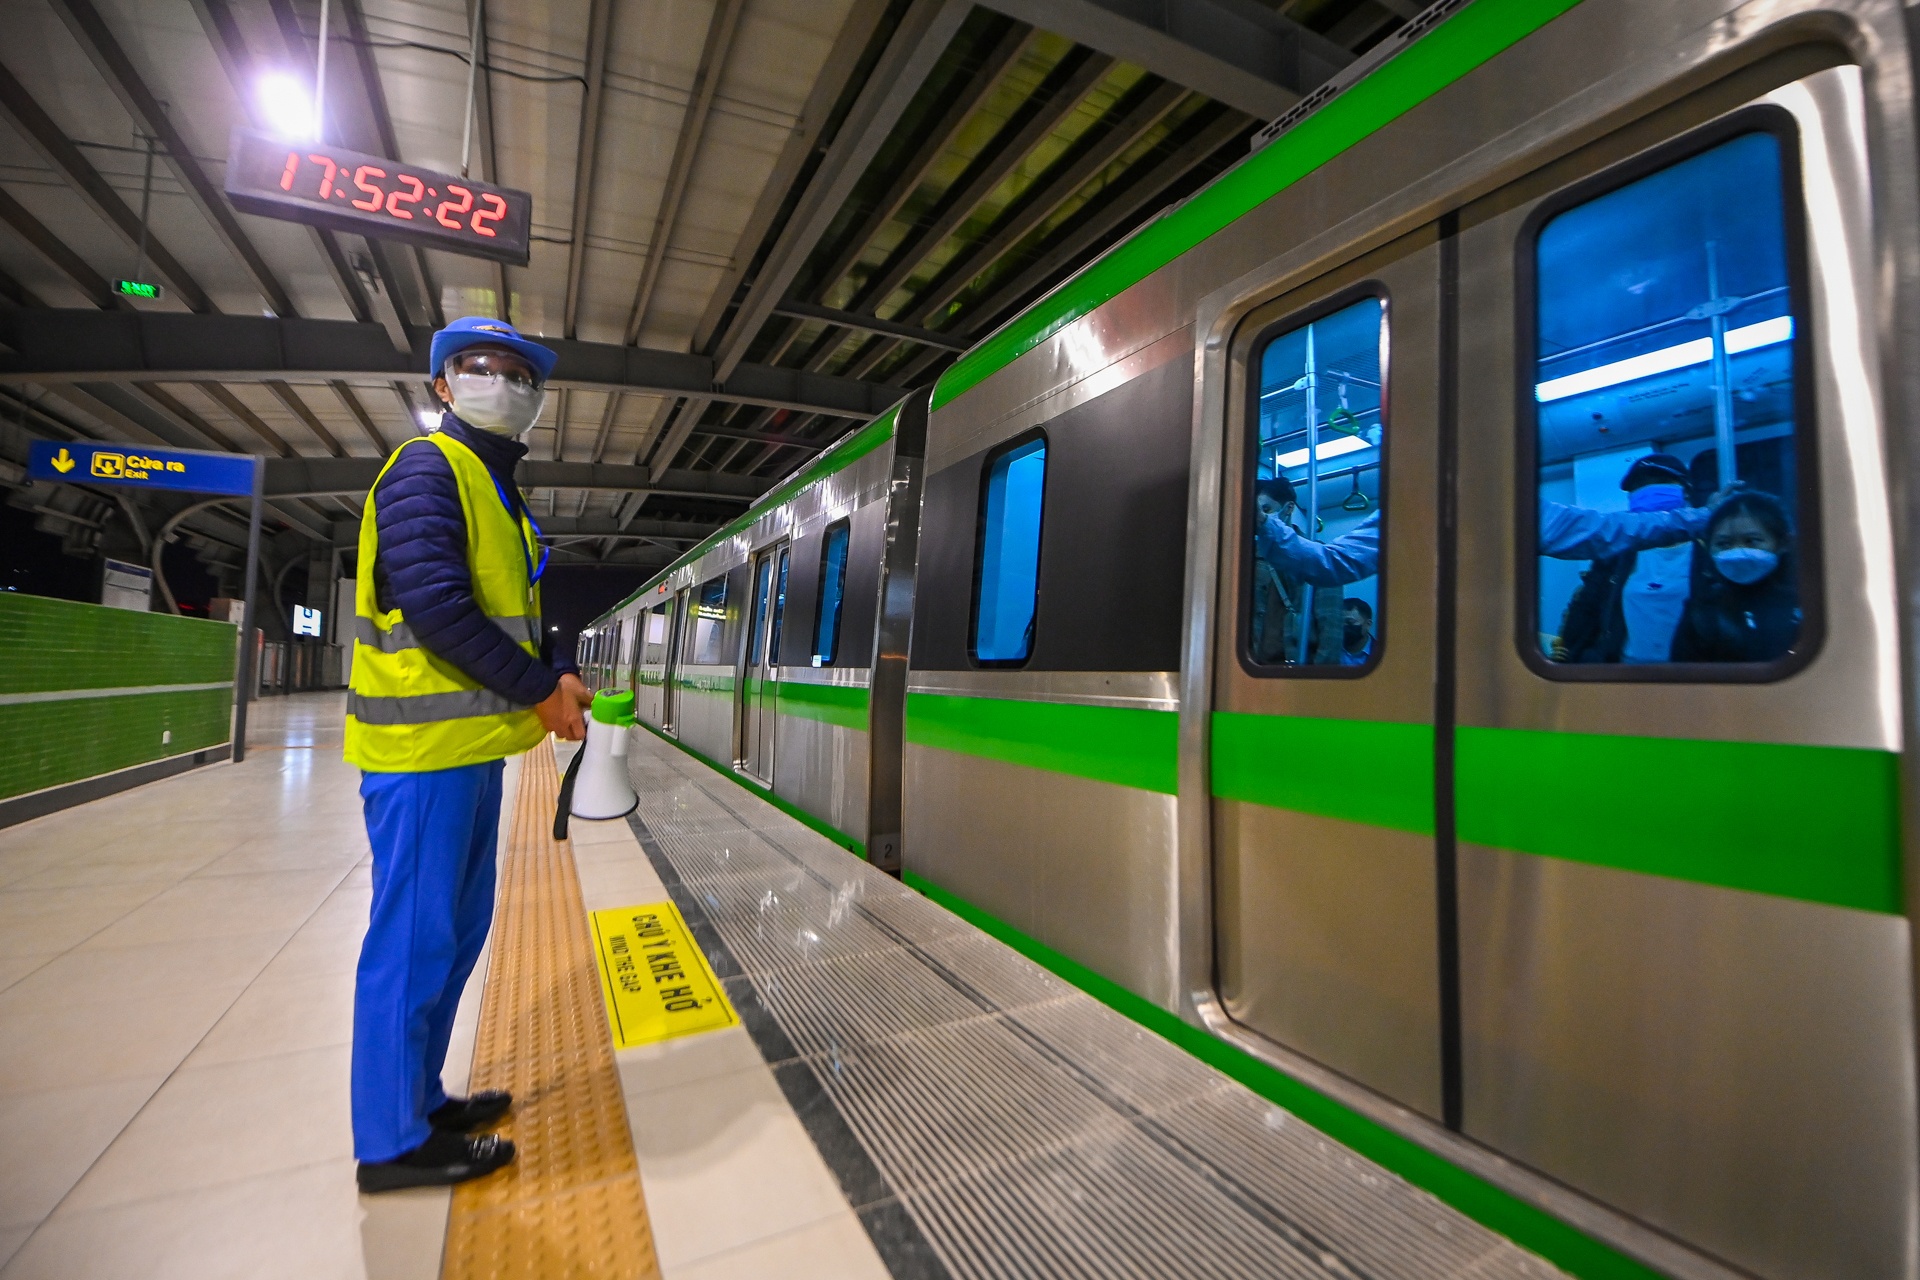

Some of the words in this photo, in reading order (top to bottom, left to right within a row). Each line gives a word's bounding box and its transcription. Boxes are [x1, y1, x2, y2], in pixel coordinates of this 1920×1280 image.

[280, 152, 507, 238] 17:52:22
[125, 469, 149, 480] Exit
[166, 461, 186, 473] ra
[884, 843, 893, 859] 2
[609, 934, 630, 955] MIND
[614, 954, 636, 972] THE
[646, 951, 686, 983] KHE
[619, 973, 642, 992] GAP
[659, 984, 713, 1012] HỞ
